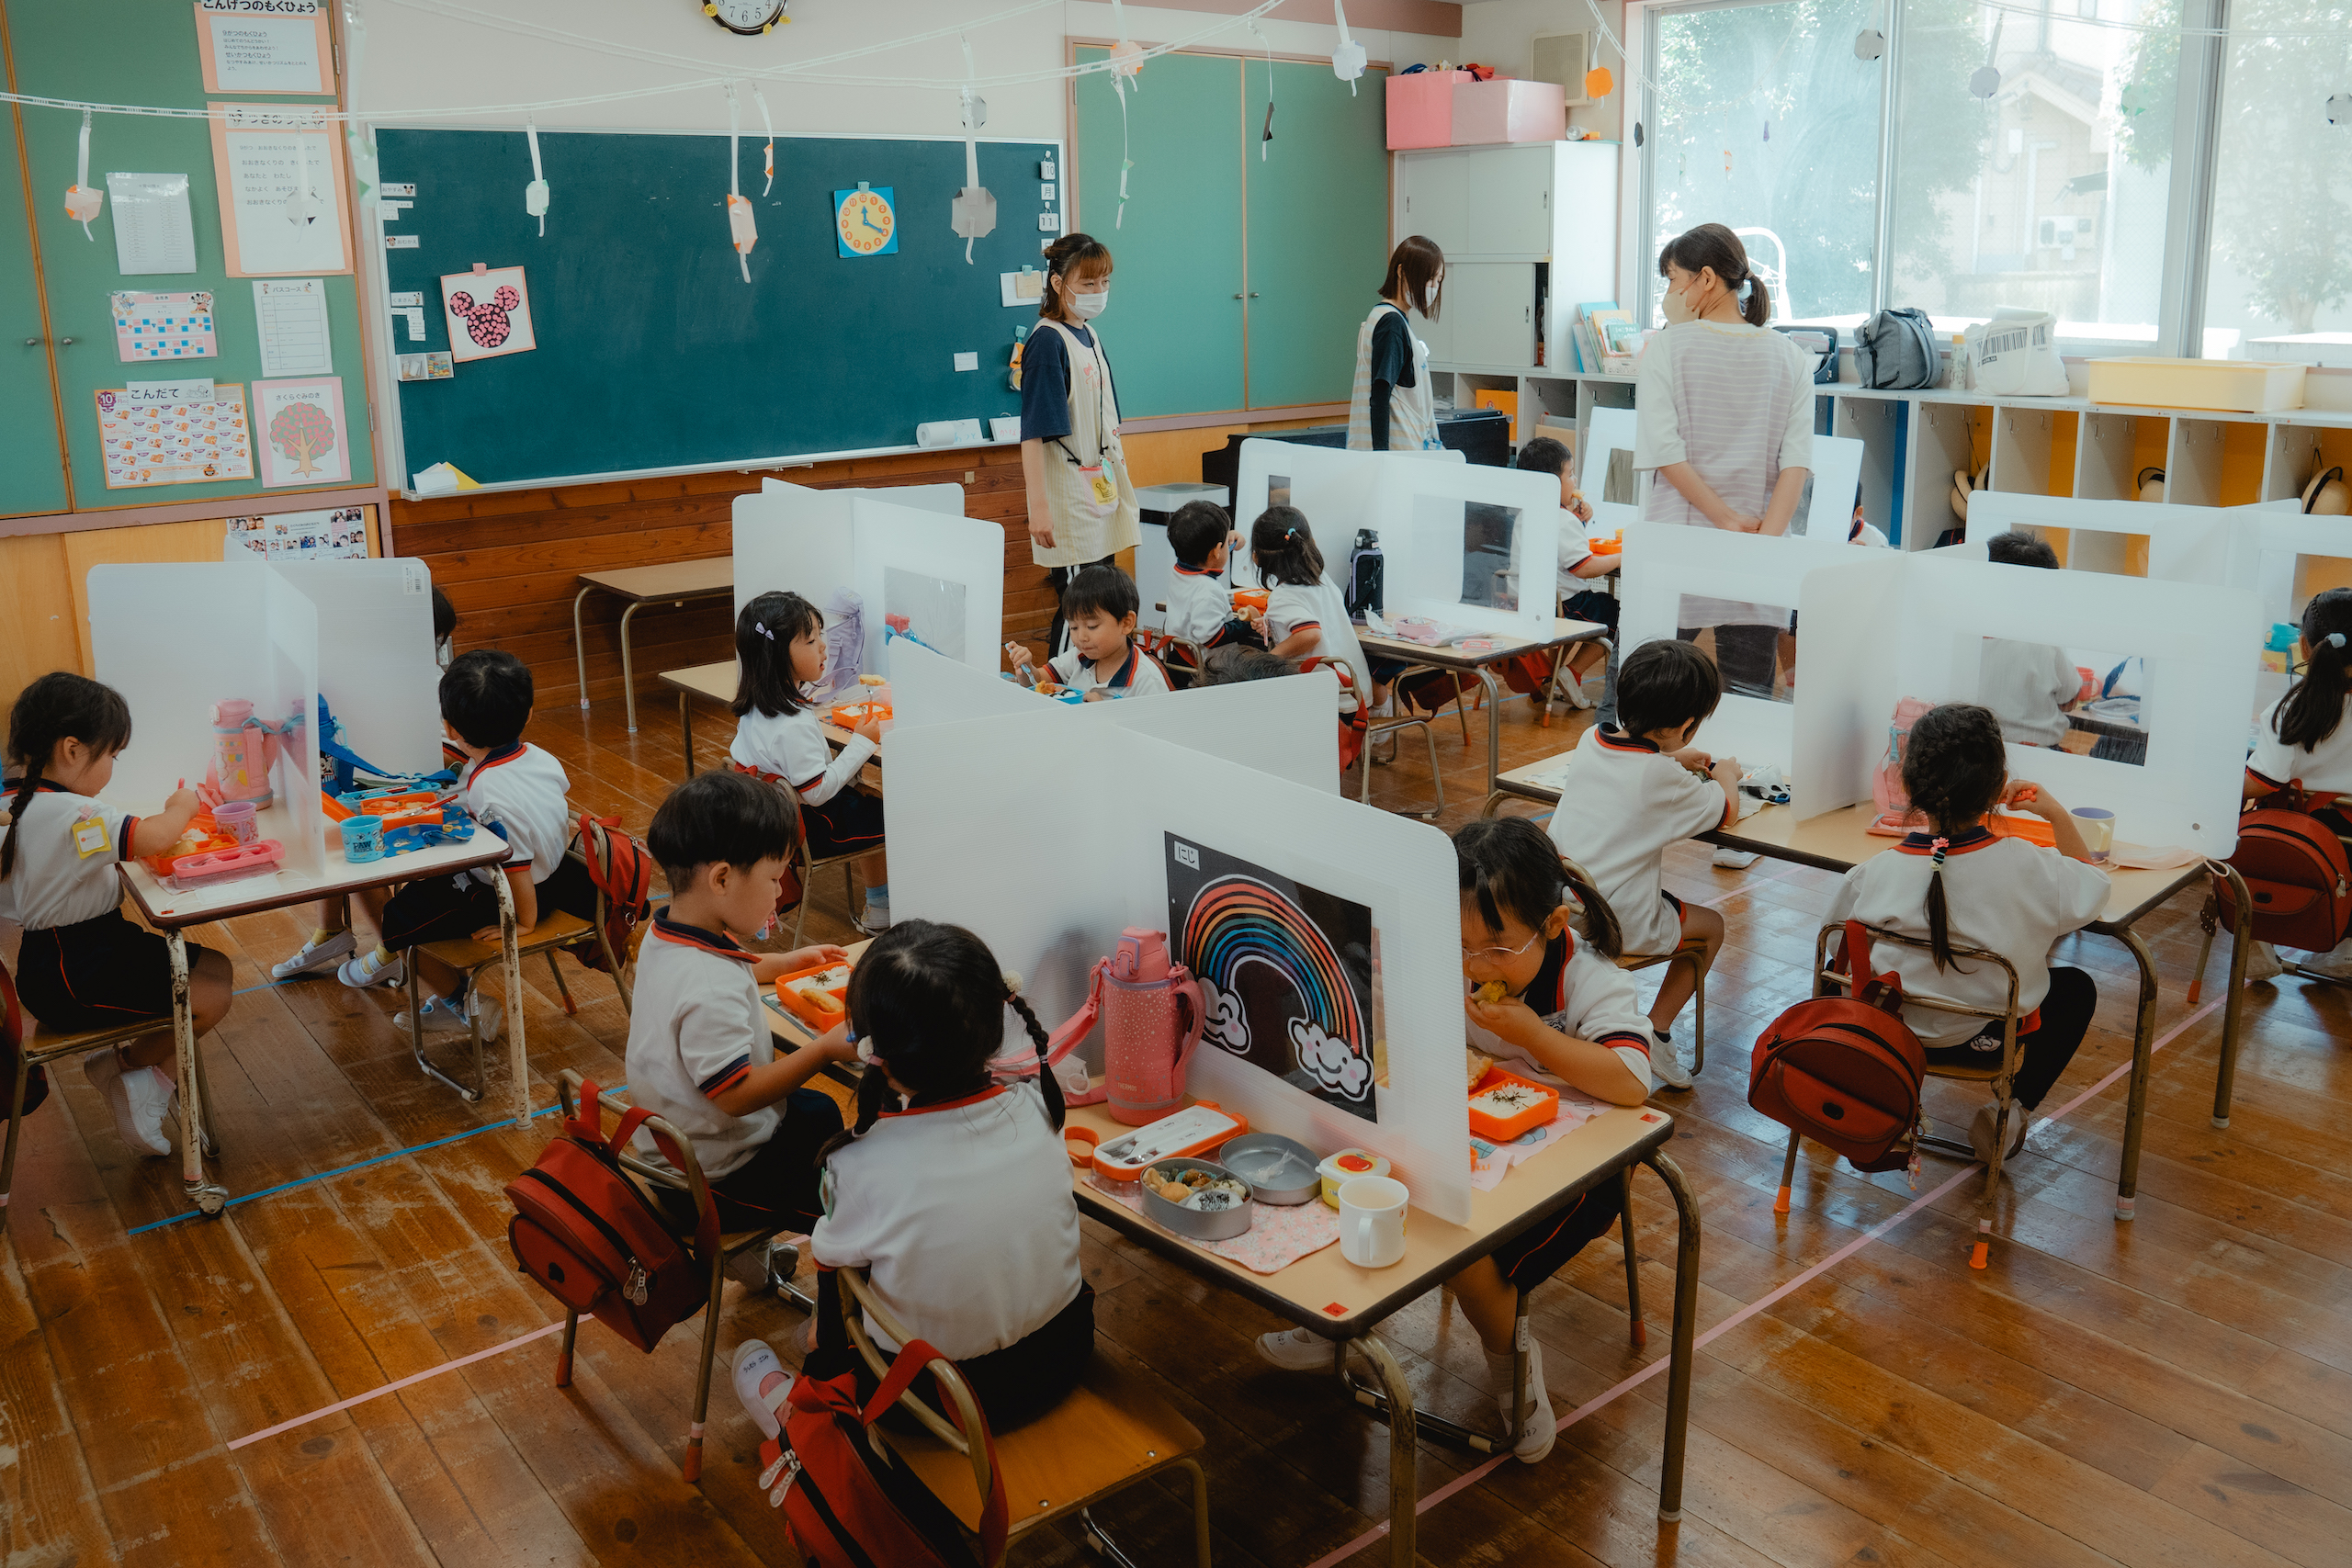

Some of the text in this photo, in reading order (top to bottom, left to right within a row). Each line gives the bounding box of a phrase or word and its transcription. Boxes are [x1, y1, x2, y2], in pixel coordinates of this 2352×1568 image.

[203, 0, 316, 13] こんげつのもくひょう
[729, 6, 736, 17] 7
[741, 10, 749, 22] 6
[754, 7, 762, 19] 5
[1046, 165, 1055, 175] 10
[1045, 186, 1052, 197] 月
[1041, 217, 1053, 227] 11
[100, 393, 113, 404] 10
[131, 388, 179, 400] こんだて
[276, 392, 320, 400] さくらぐみのき
[353, 840, 372, 849] PAW
[1178, 846, 1195, 863] にじ
[1117, 1082, 1137, 1092] THERMOS
